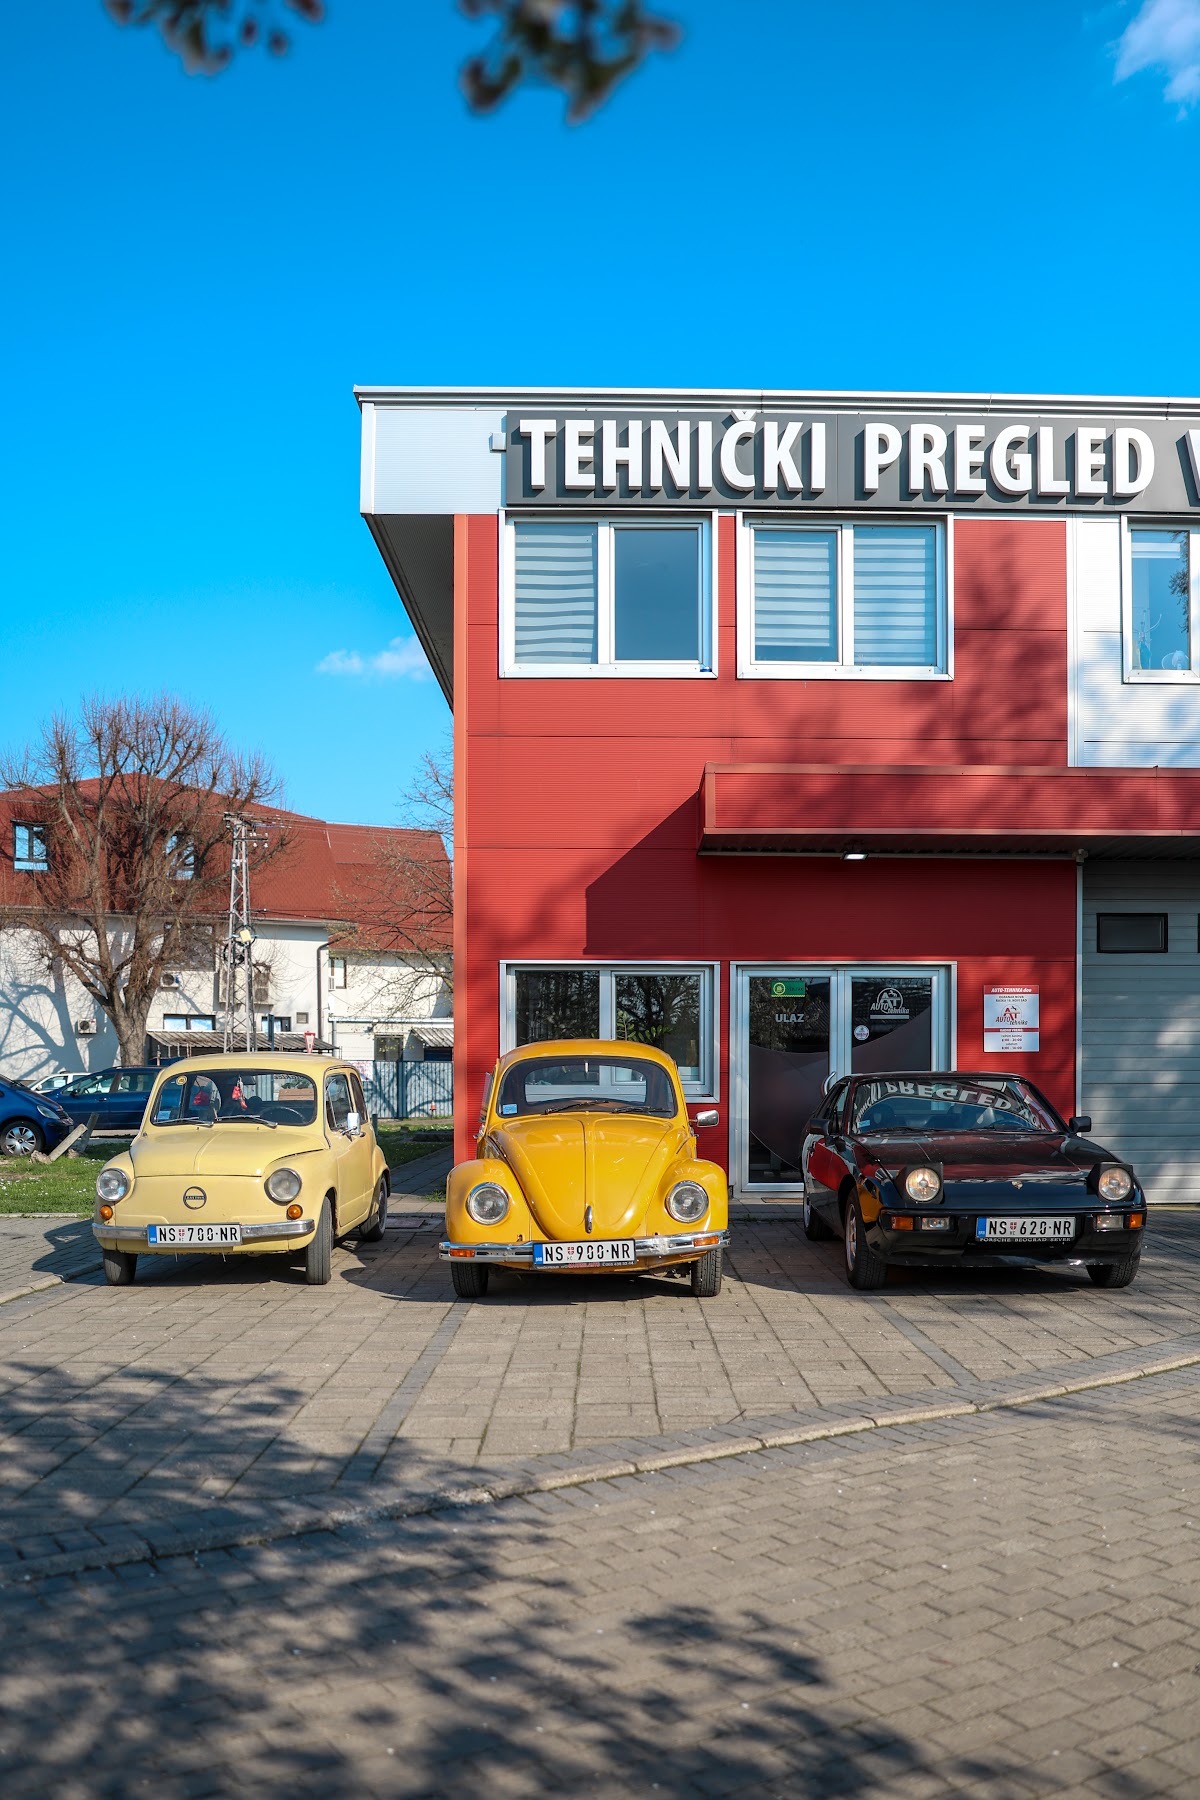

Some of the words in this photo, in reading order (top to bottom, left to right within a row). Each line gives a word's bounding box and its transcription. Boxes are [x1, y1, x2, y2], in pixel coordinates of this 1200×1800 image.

[519, 409, 826, 493] TEHNIČKI
[863, 423, 1155, 498] PREGLED
[870, 1003, 889, 1011] AUTO
[775, 1013, 805, 1023] ULAZ
[159, 1227, 176, 1242] NS
[989, 1220, 1007, 1235] NS
[545, 1246, 563, 1262] NS
